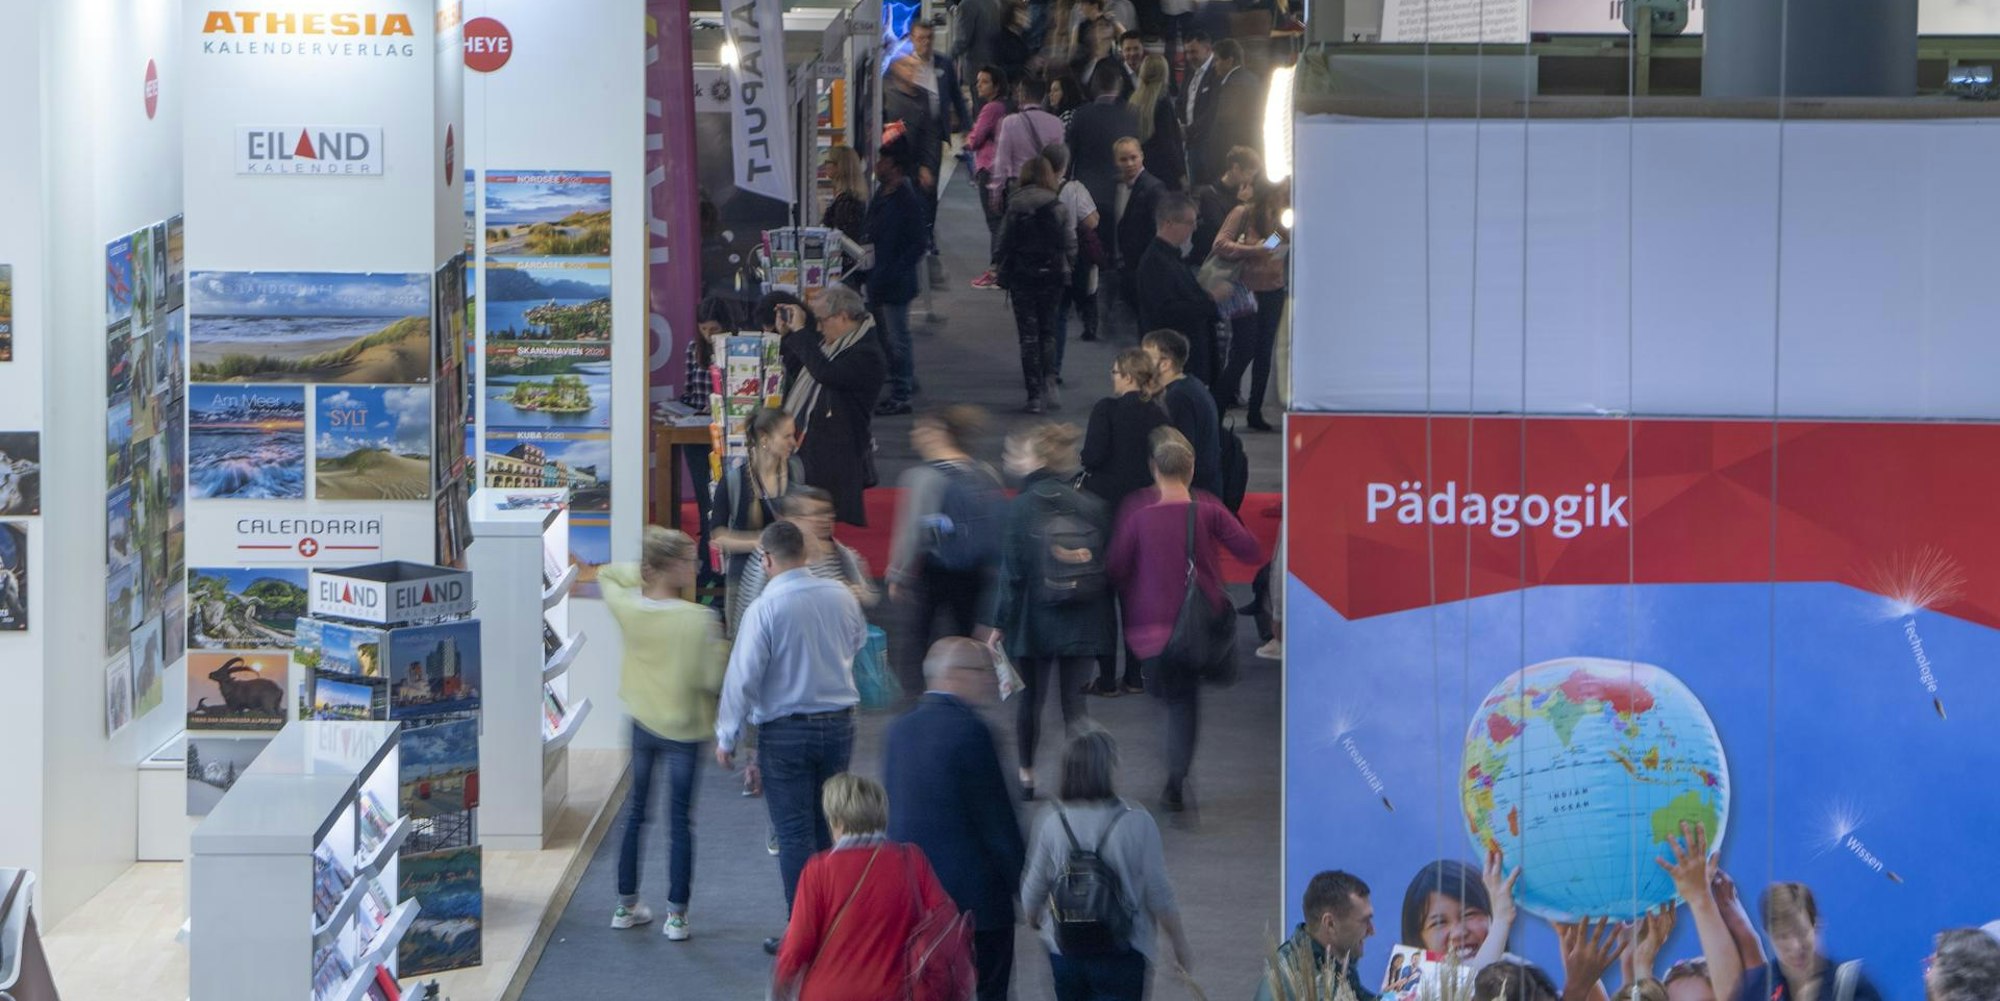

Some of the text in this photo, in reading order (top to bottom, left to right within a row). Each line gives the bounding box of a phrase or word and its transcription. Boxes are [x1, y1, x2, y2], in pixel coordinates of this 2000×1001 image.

[202, 11, 415, 36] ATHESIA
[203, 41, 414, 57] KALENDERVERLAG
[464, 36, 509, 53] HEYE
[248, 127, 370, 160] EILAND
[248, 163, 370, 174] KALENDER
[516, 175, 561, 184] NORDSEE
[517, 346, 583, 356] SKANDINAVIEN
[584, 348, 605, 356] 2020
[212, 393, 281, 407] Am Meer
[330, 409, 368, 427] SYLT
[516, 431, 543, 440] KUBA
[1366, 481, 1629, 539] Pädagogik
[236, 519, 381, 535] CALENDARIA
[320, 580, 378, 608] EILAND
[396, 580, 463, 609] EILAND
[1904, 618, 1938, 693] Technologie
[1342, 736, 1385, 793] Kreativität
[1549, 788, 1589, 800] INDIAN
[1847, 836, 1884, 872] Wissen
